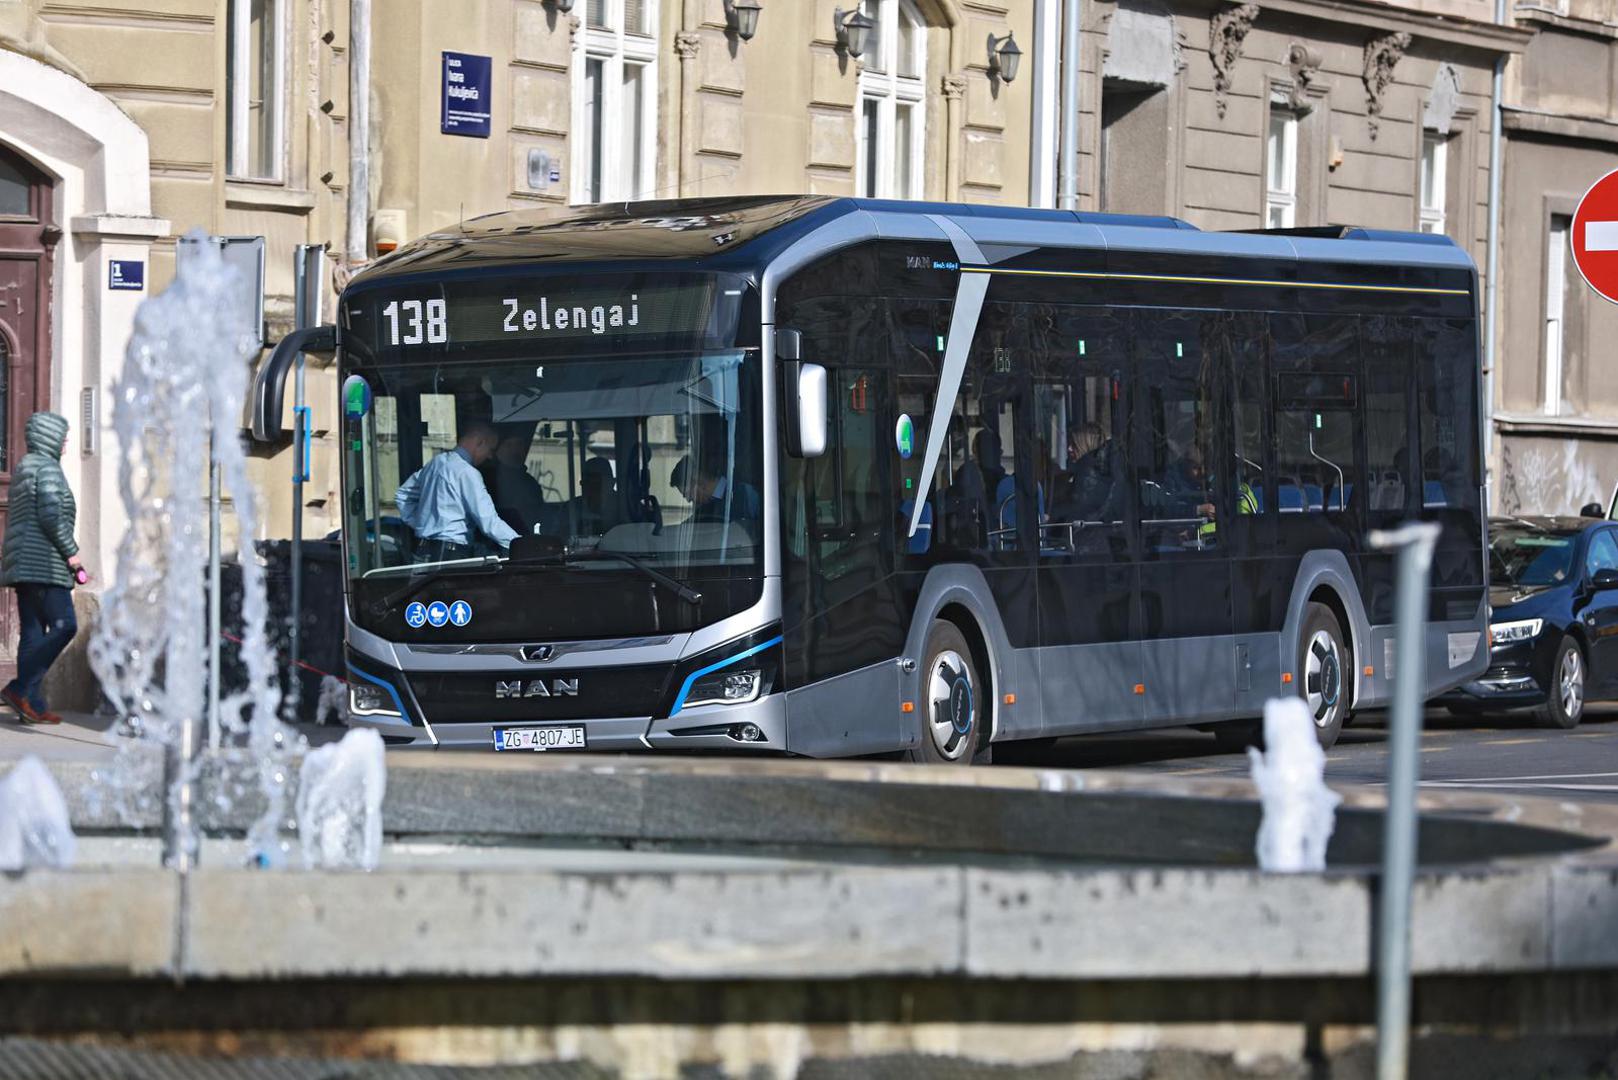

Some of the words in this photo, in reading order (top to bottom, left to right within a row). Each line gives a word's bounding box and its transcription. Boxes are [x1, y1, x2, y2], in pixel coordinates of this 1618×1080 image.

[113, 263, 123, 277] 1
[383, 299, 447, 345] 138
[503, 294, 638, 334] Zelengaj
[496, 678, 579, 698] MAN
[504, 732, 521, 747] ZG
